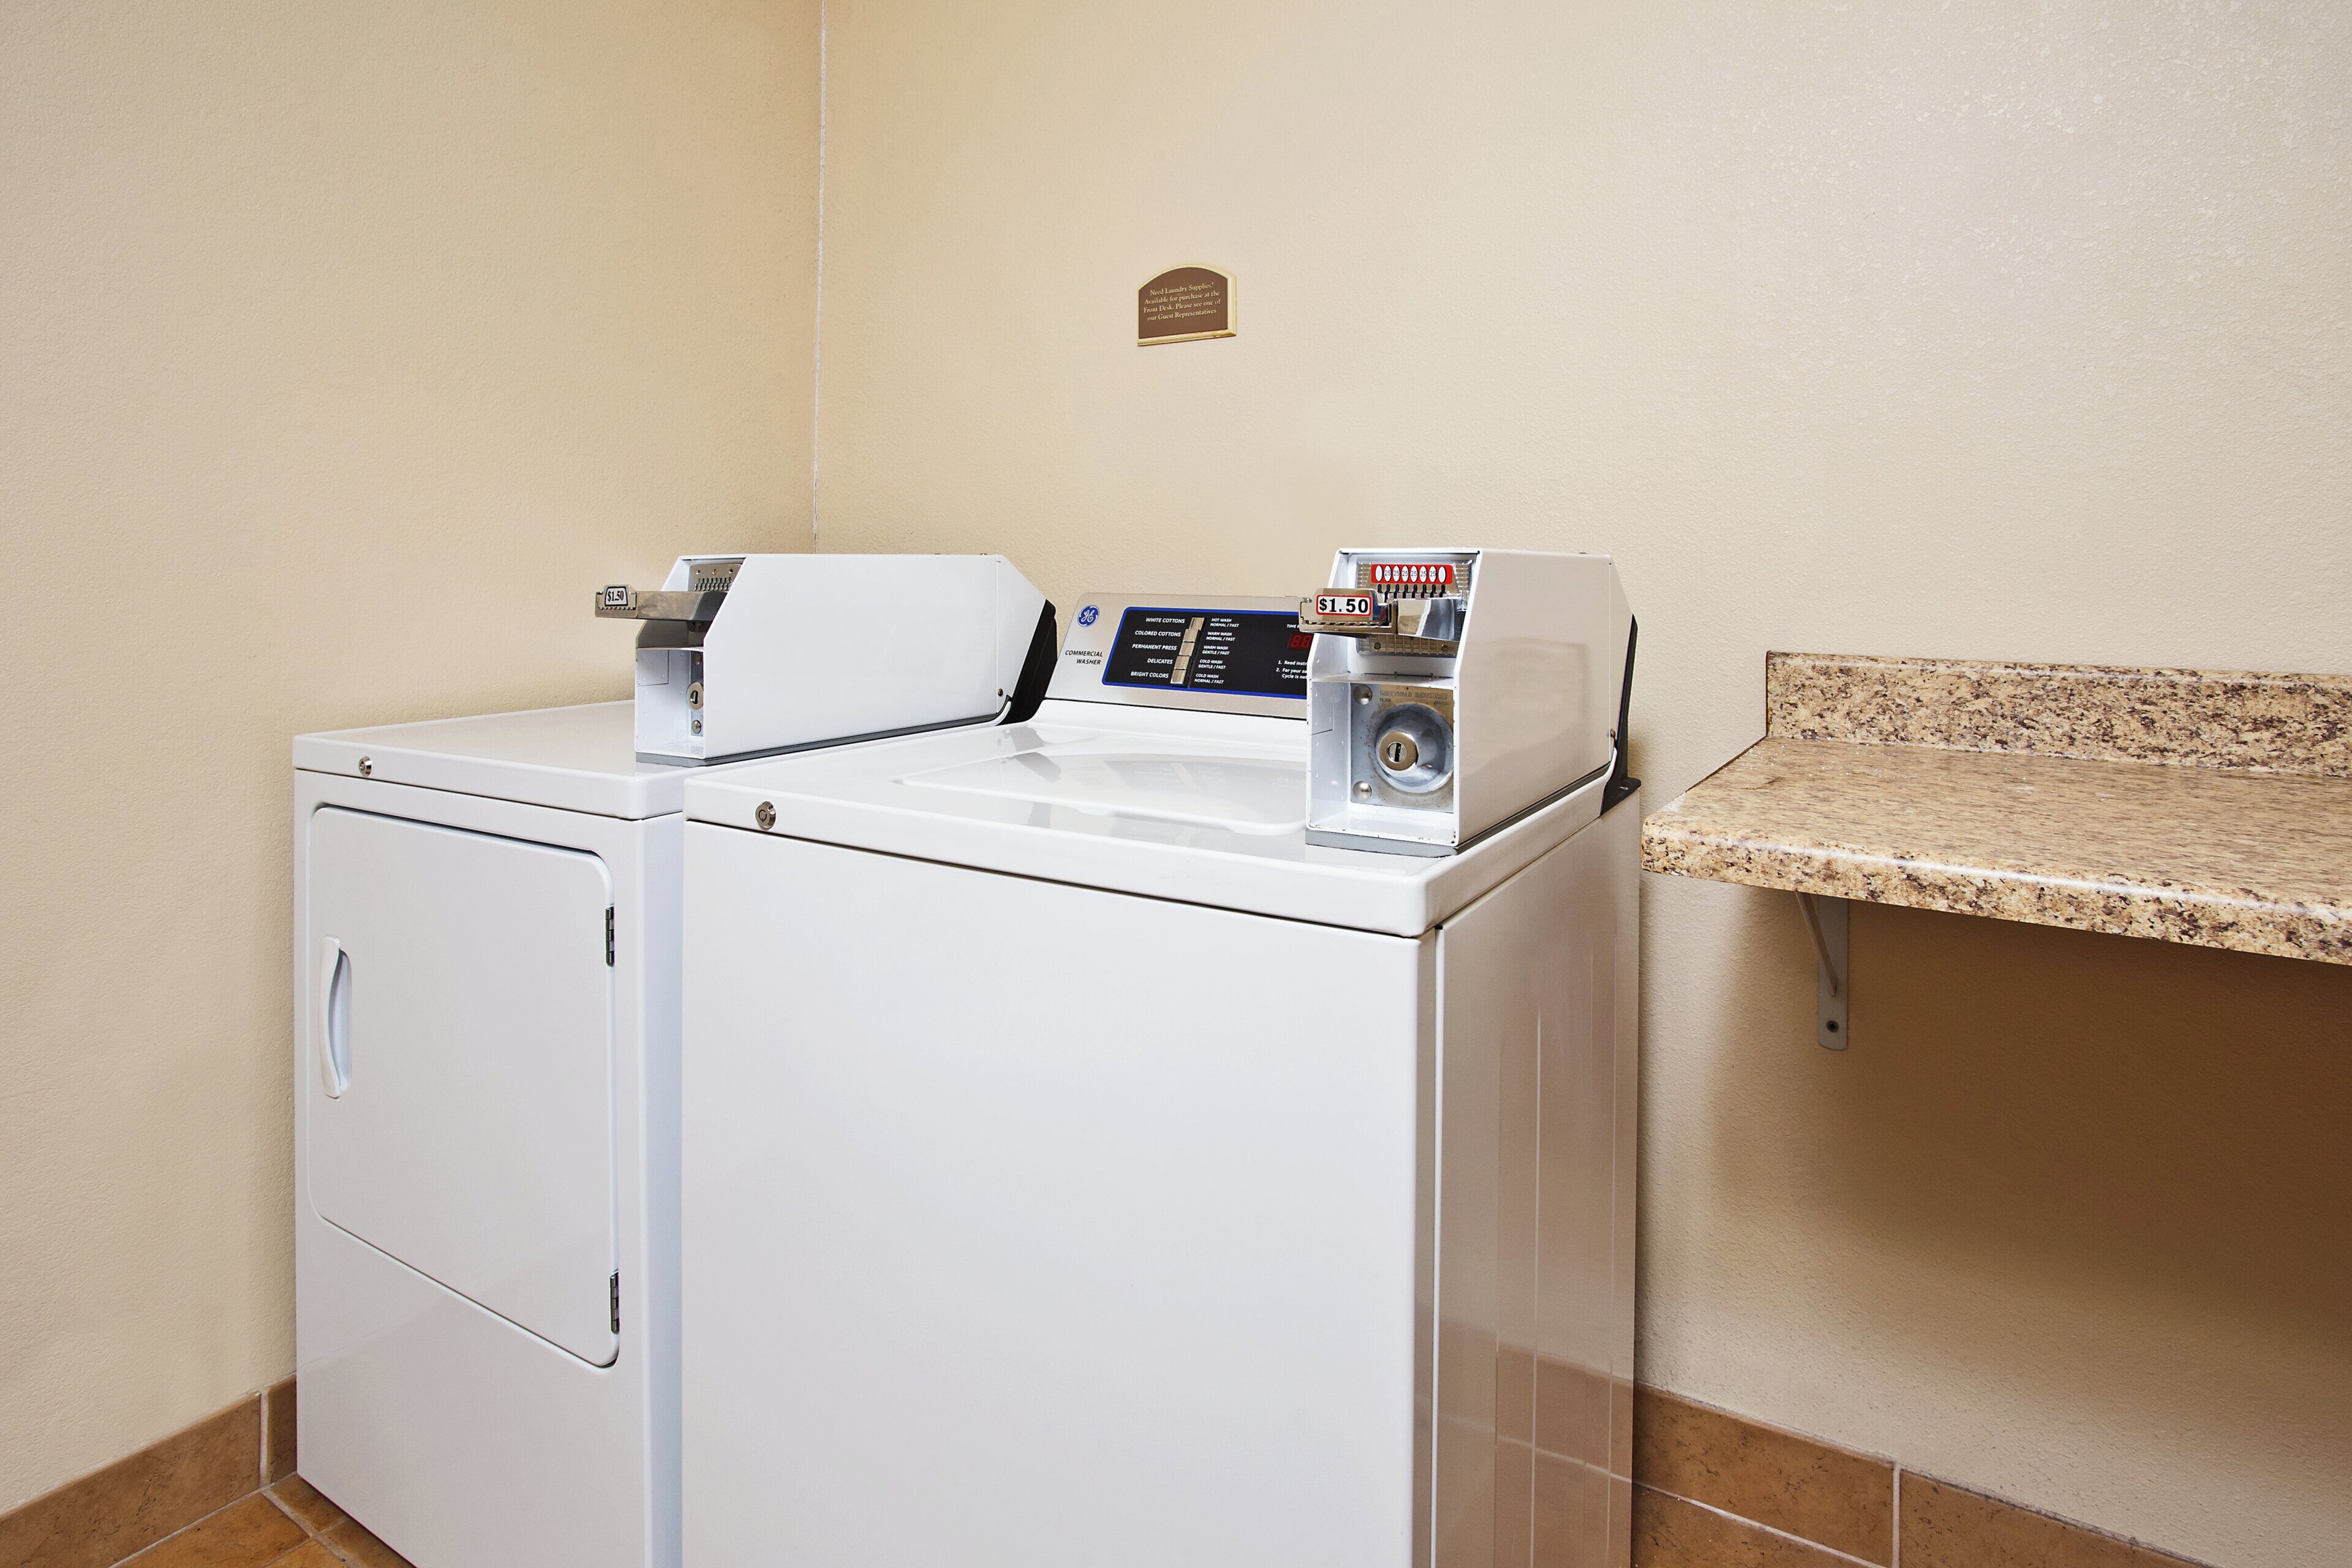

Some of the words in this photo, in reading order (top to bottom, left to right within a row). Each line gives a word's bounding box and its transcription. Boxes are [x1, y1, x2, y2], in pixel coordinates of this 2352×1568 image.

[1189, 282, 1214, 292] Supplies?
[1144, 296, 1169, 305] Available
[1179, 293, 1203, 302] purchase
[1175, 309, 1216, 318] Representatives
[607, 591, 624, 602] $1.50
[1319, 598, 1369, 613] $1.50
